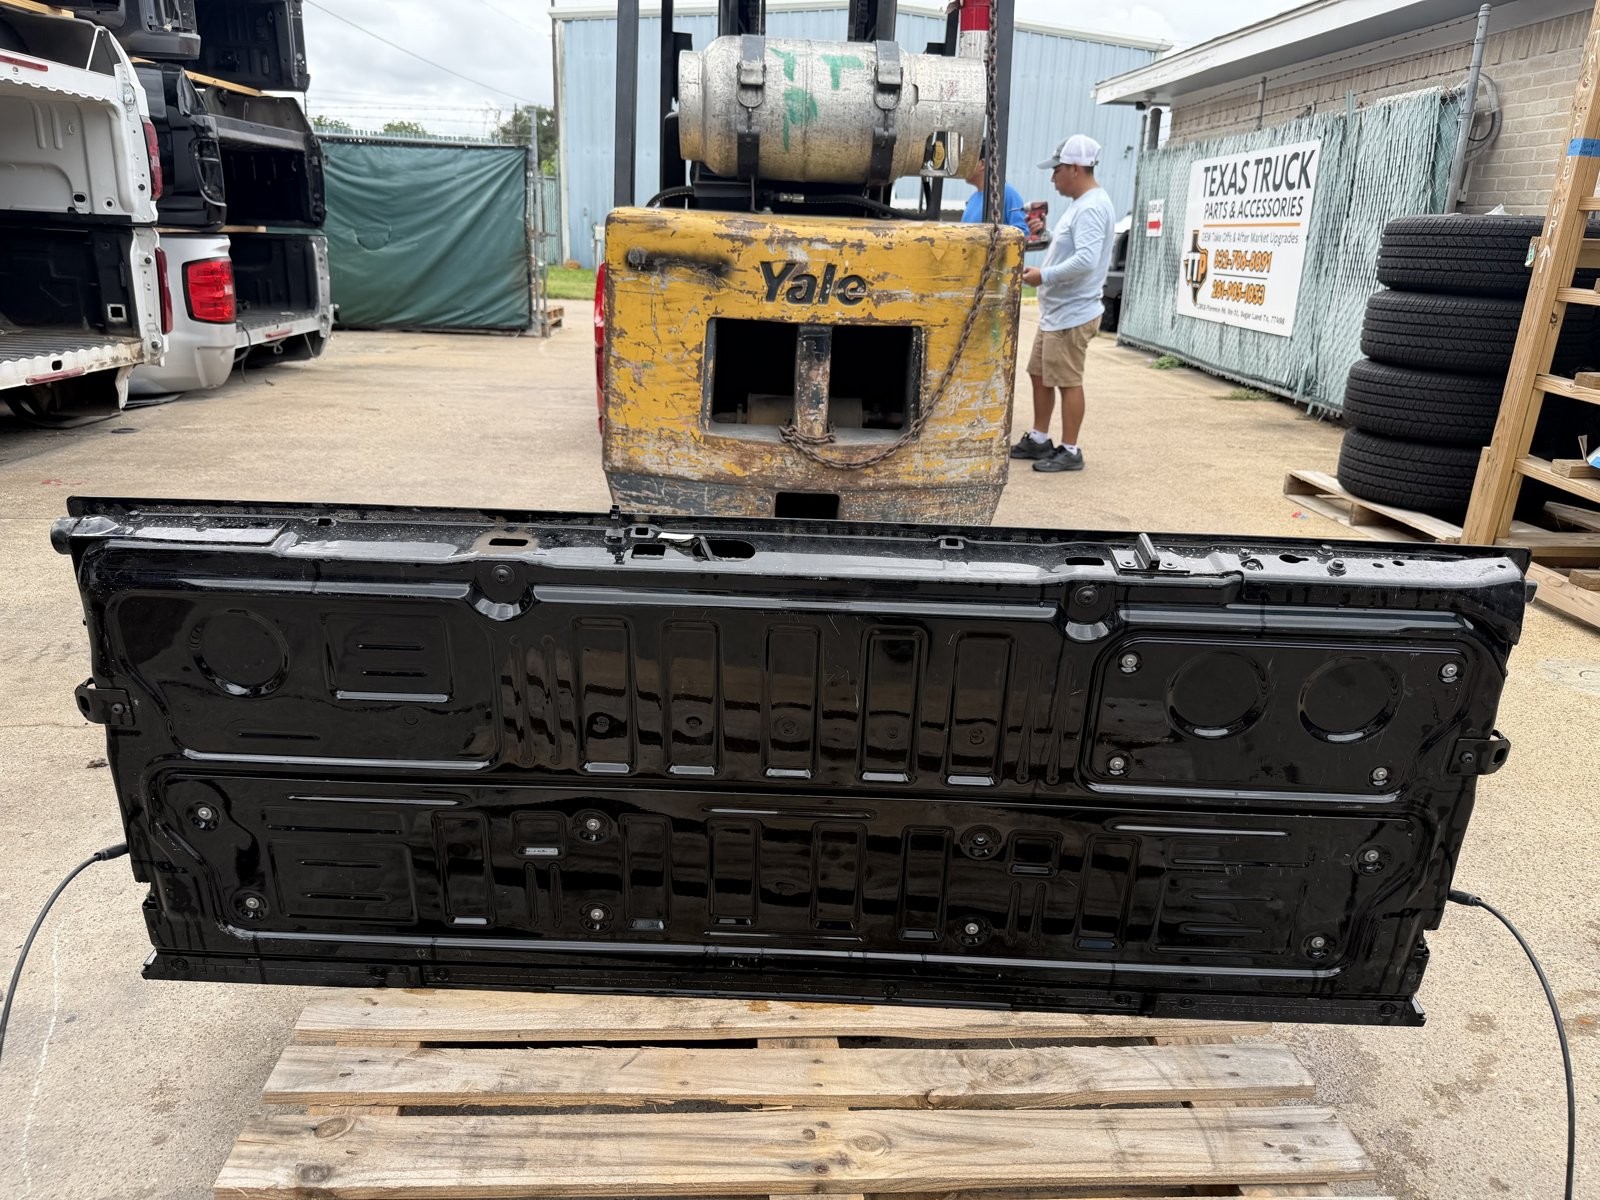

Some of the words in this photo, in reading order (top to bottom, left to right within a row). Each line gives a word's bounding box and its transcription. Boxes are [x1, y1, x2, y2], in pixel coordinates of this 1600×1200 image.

[1203, 160, 1250, 198] TEXAS
[1252, 149, 1316, 194] TRUCK
[1204, 201, 1228, 219] PARTS
[1229, 201, 1236, 219] &
[1237, 196, 1304, 219] ACCESSORIES
[1546, 203, 1560, 239] UP
[1237, 232, 1250, 243] After
[1250, 232, 1270, 244] Market
[1269, 232, 1299, 247] Upgrades
[760, 260, 867, 306] Yale
